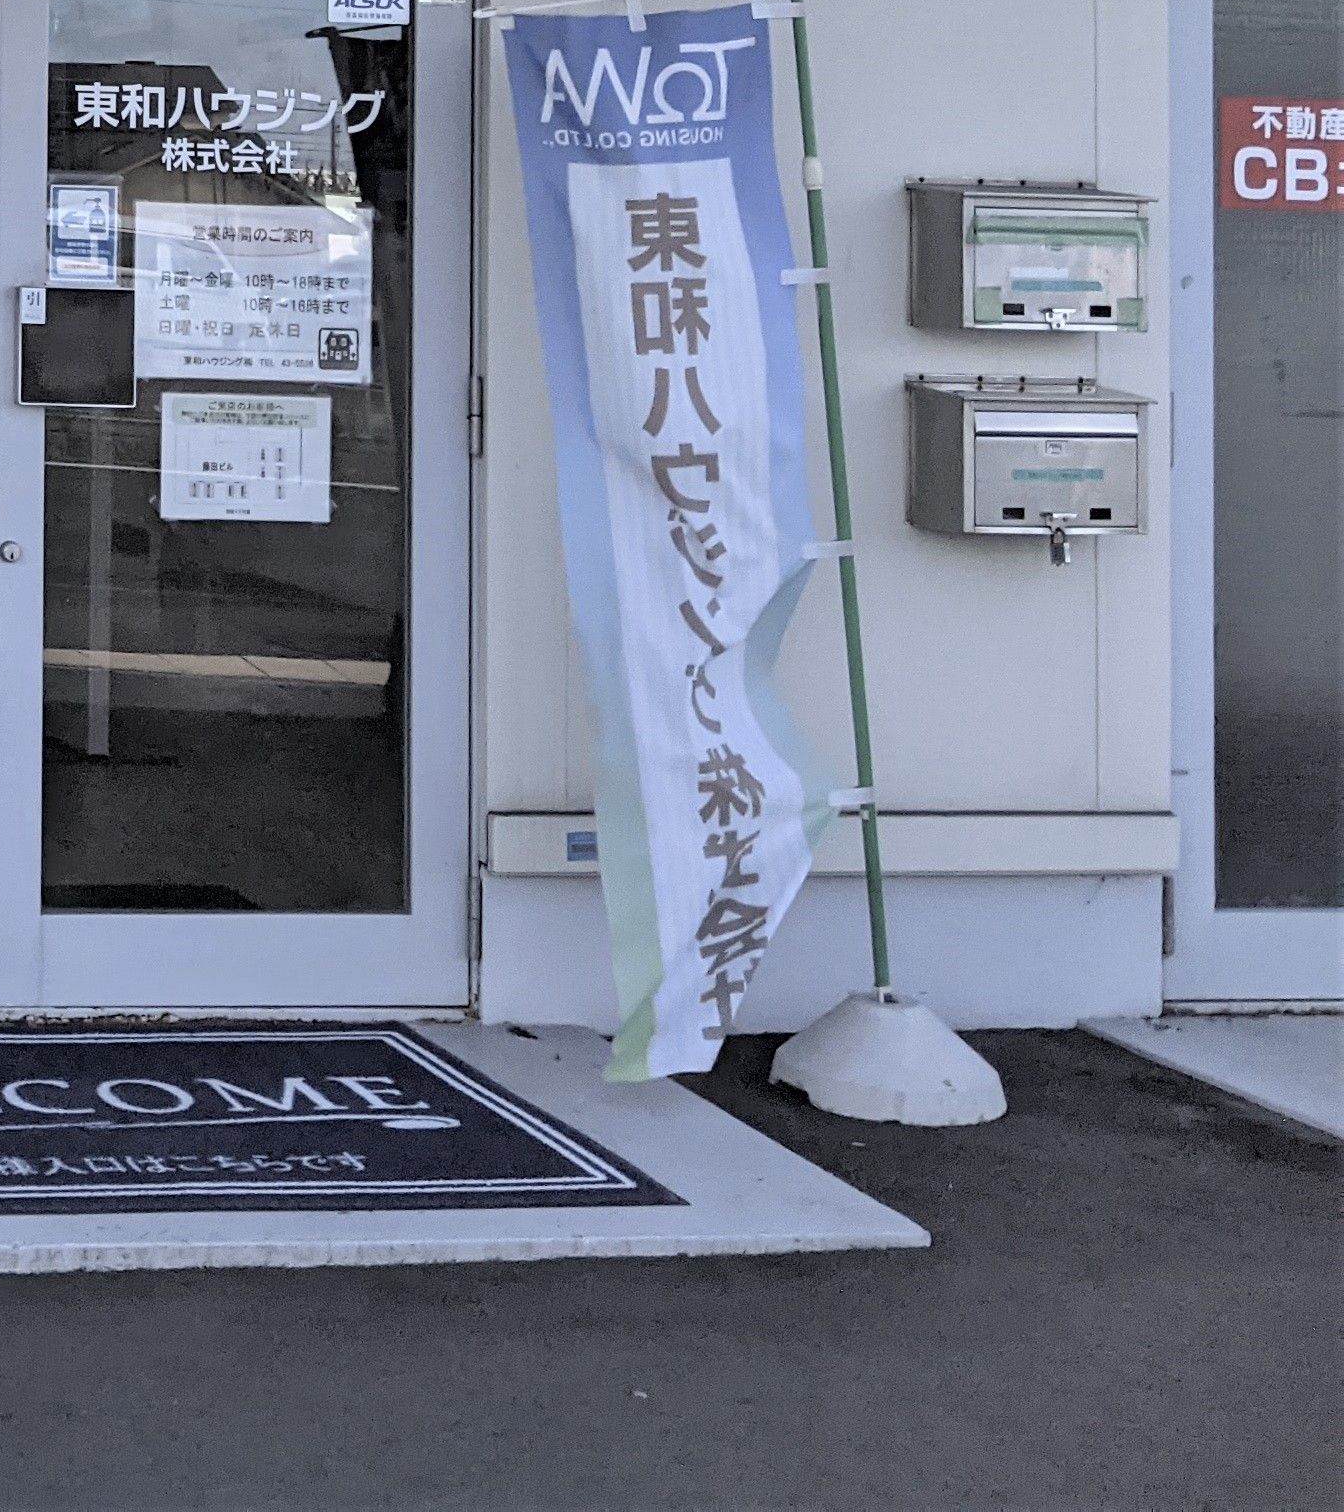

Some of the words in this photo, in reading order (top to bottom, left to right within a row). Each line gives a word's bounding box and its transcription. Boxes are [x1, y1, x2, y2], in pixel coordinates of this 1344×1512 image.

[73, 81, 385, 133] 東和ハウジング
[161, 137, 300, 176] 株式会社
[1233, 146, 1344, 202] CB
[192, 224, 314, 244] 営業時間のご案内
